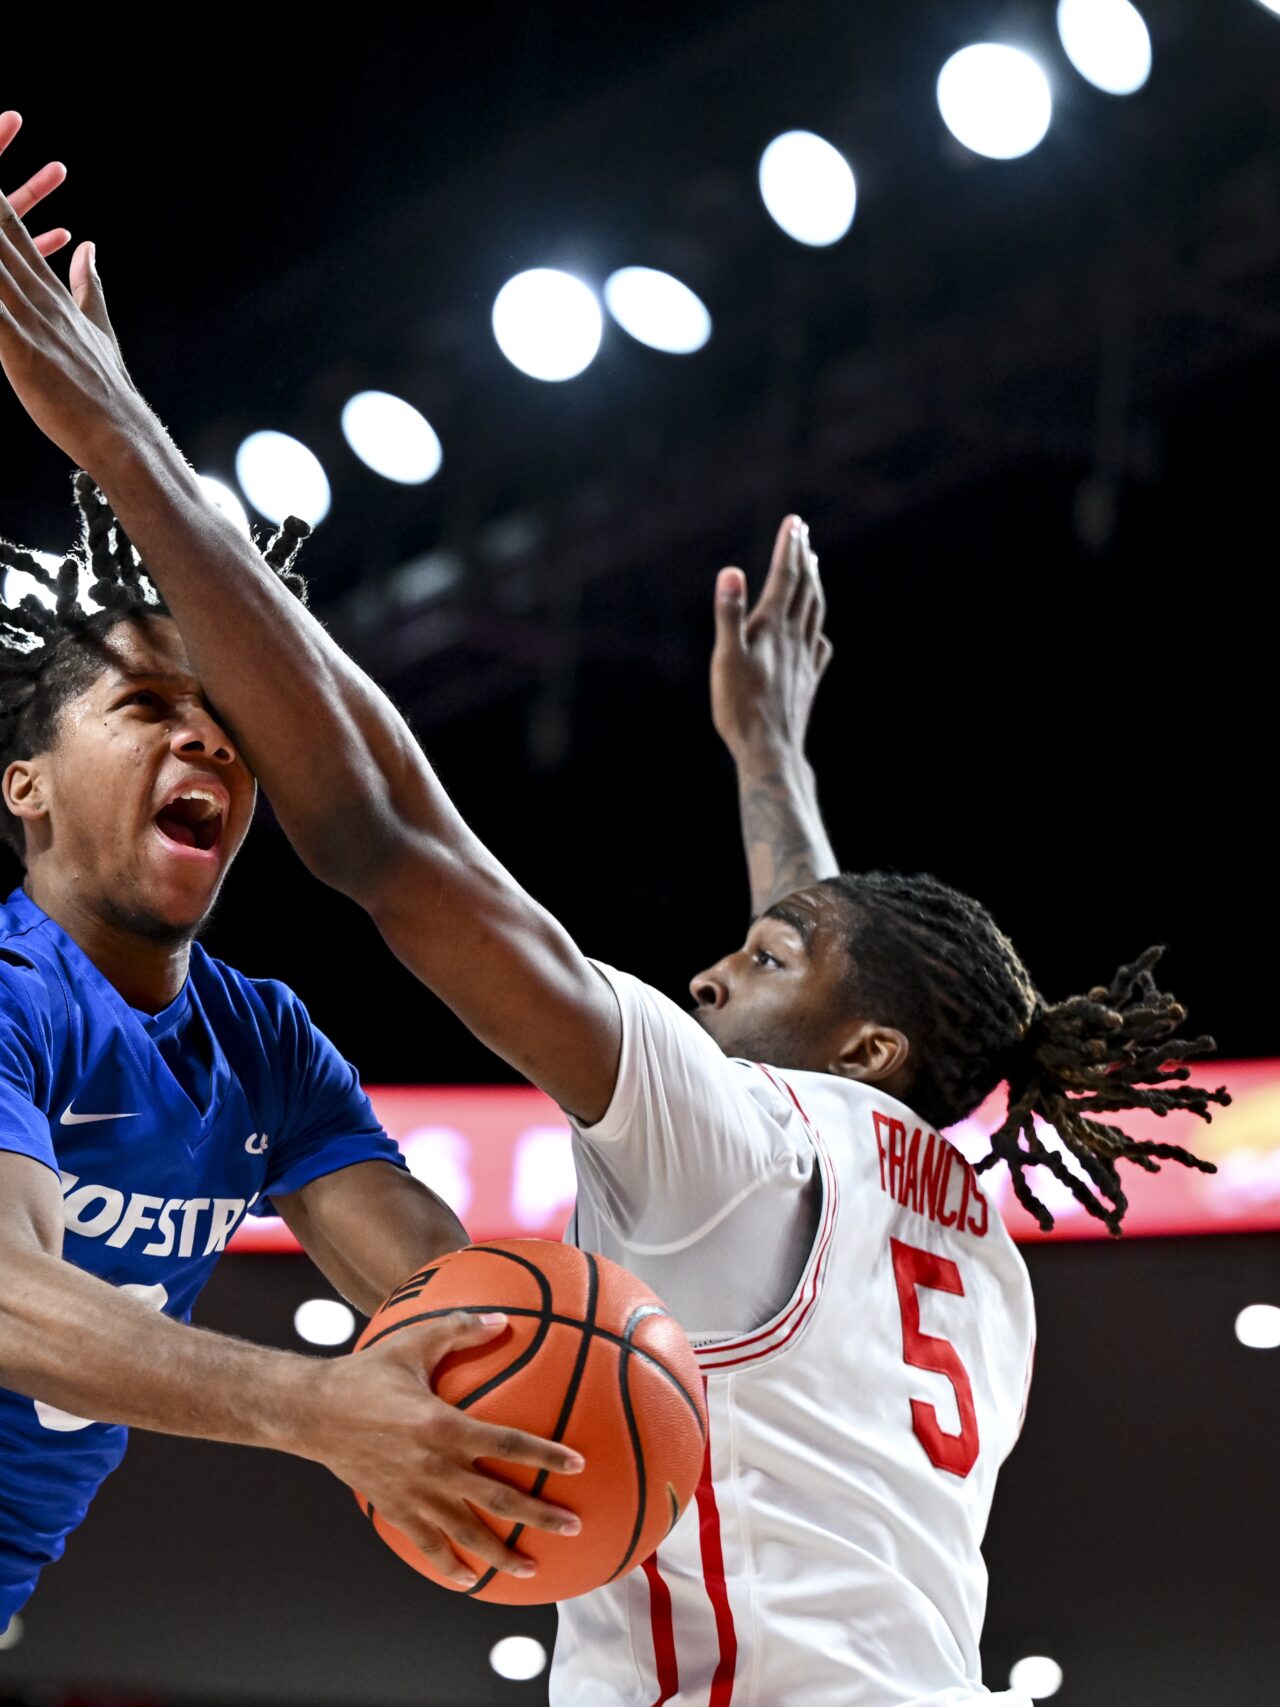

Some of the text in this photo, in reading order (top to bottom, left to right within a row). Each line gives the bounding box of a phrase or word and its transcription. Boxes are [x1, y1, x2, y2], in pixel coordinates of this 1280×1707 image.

[58, 1169, 260, 1258] OFSTR
[871, 1110, 988, 1238] FRANCIS
[889, 1236, 980, 1479] 5
